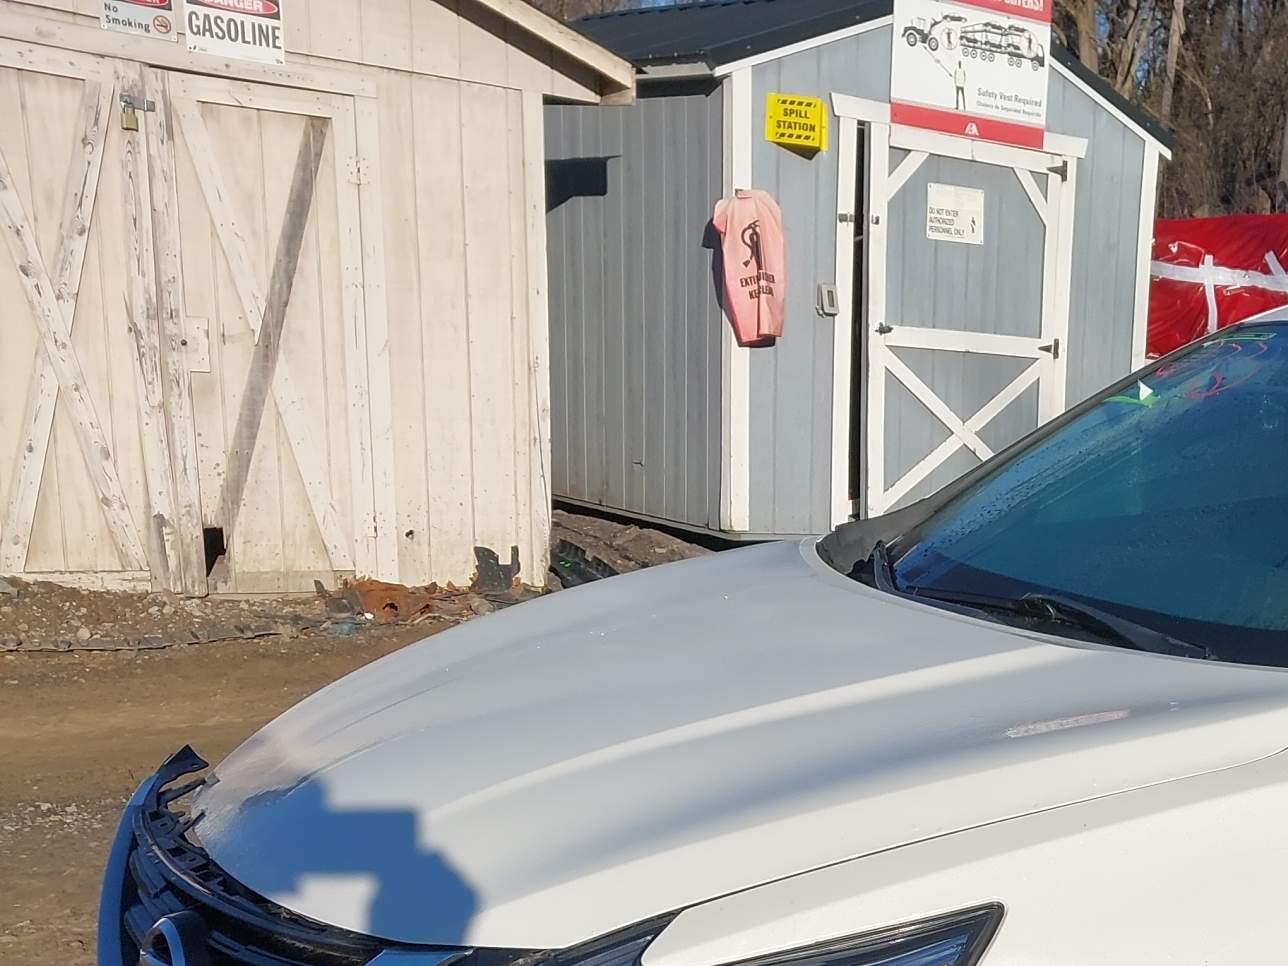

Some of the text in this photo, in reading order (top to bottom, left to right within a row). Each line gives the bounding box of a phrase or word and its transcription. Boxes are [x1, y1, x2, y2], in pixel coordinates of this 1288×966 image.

[104, 2, 118, 13] No
[105, 14, 151, 33] Smoking
[188, 11, 282, 49] GASOLINE
[783, 108, 811, 119] SPILL
[775, 119, 817, 133] STATION
